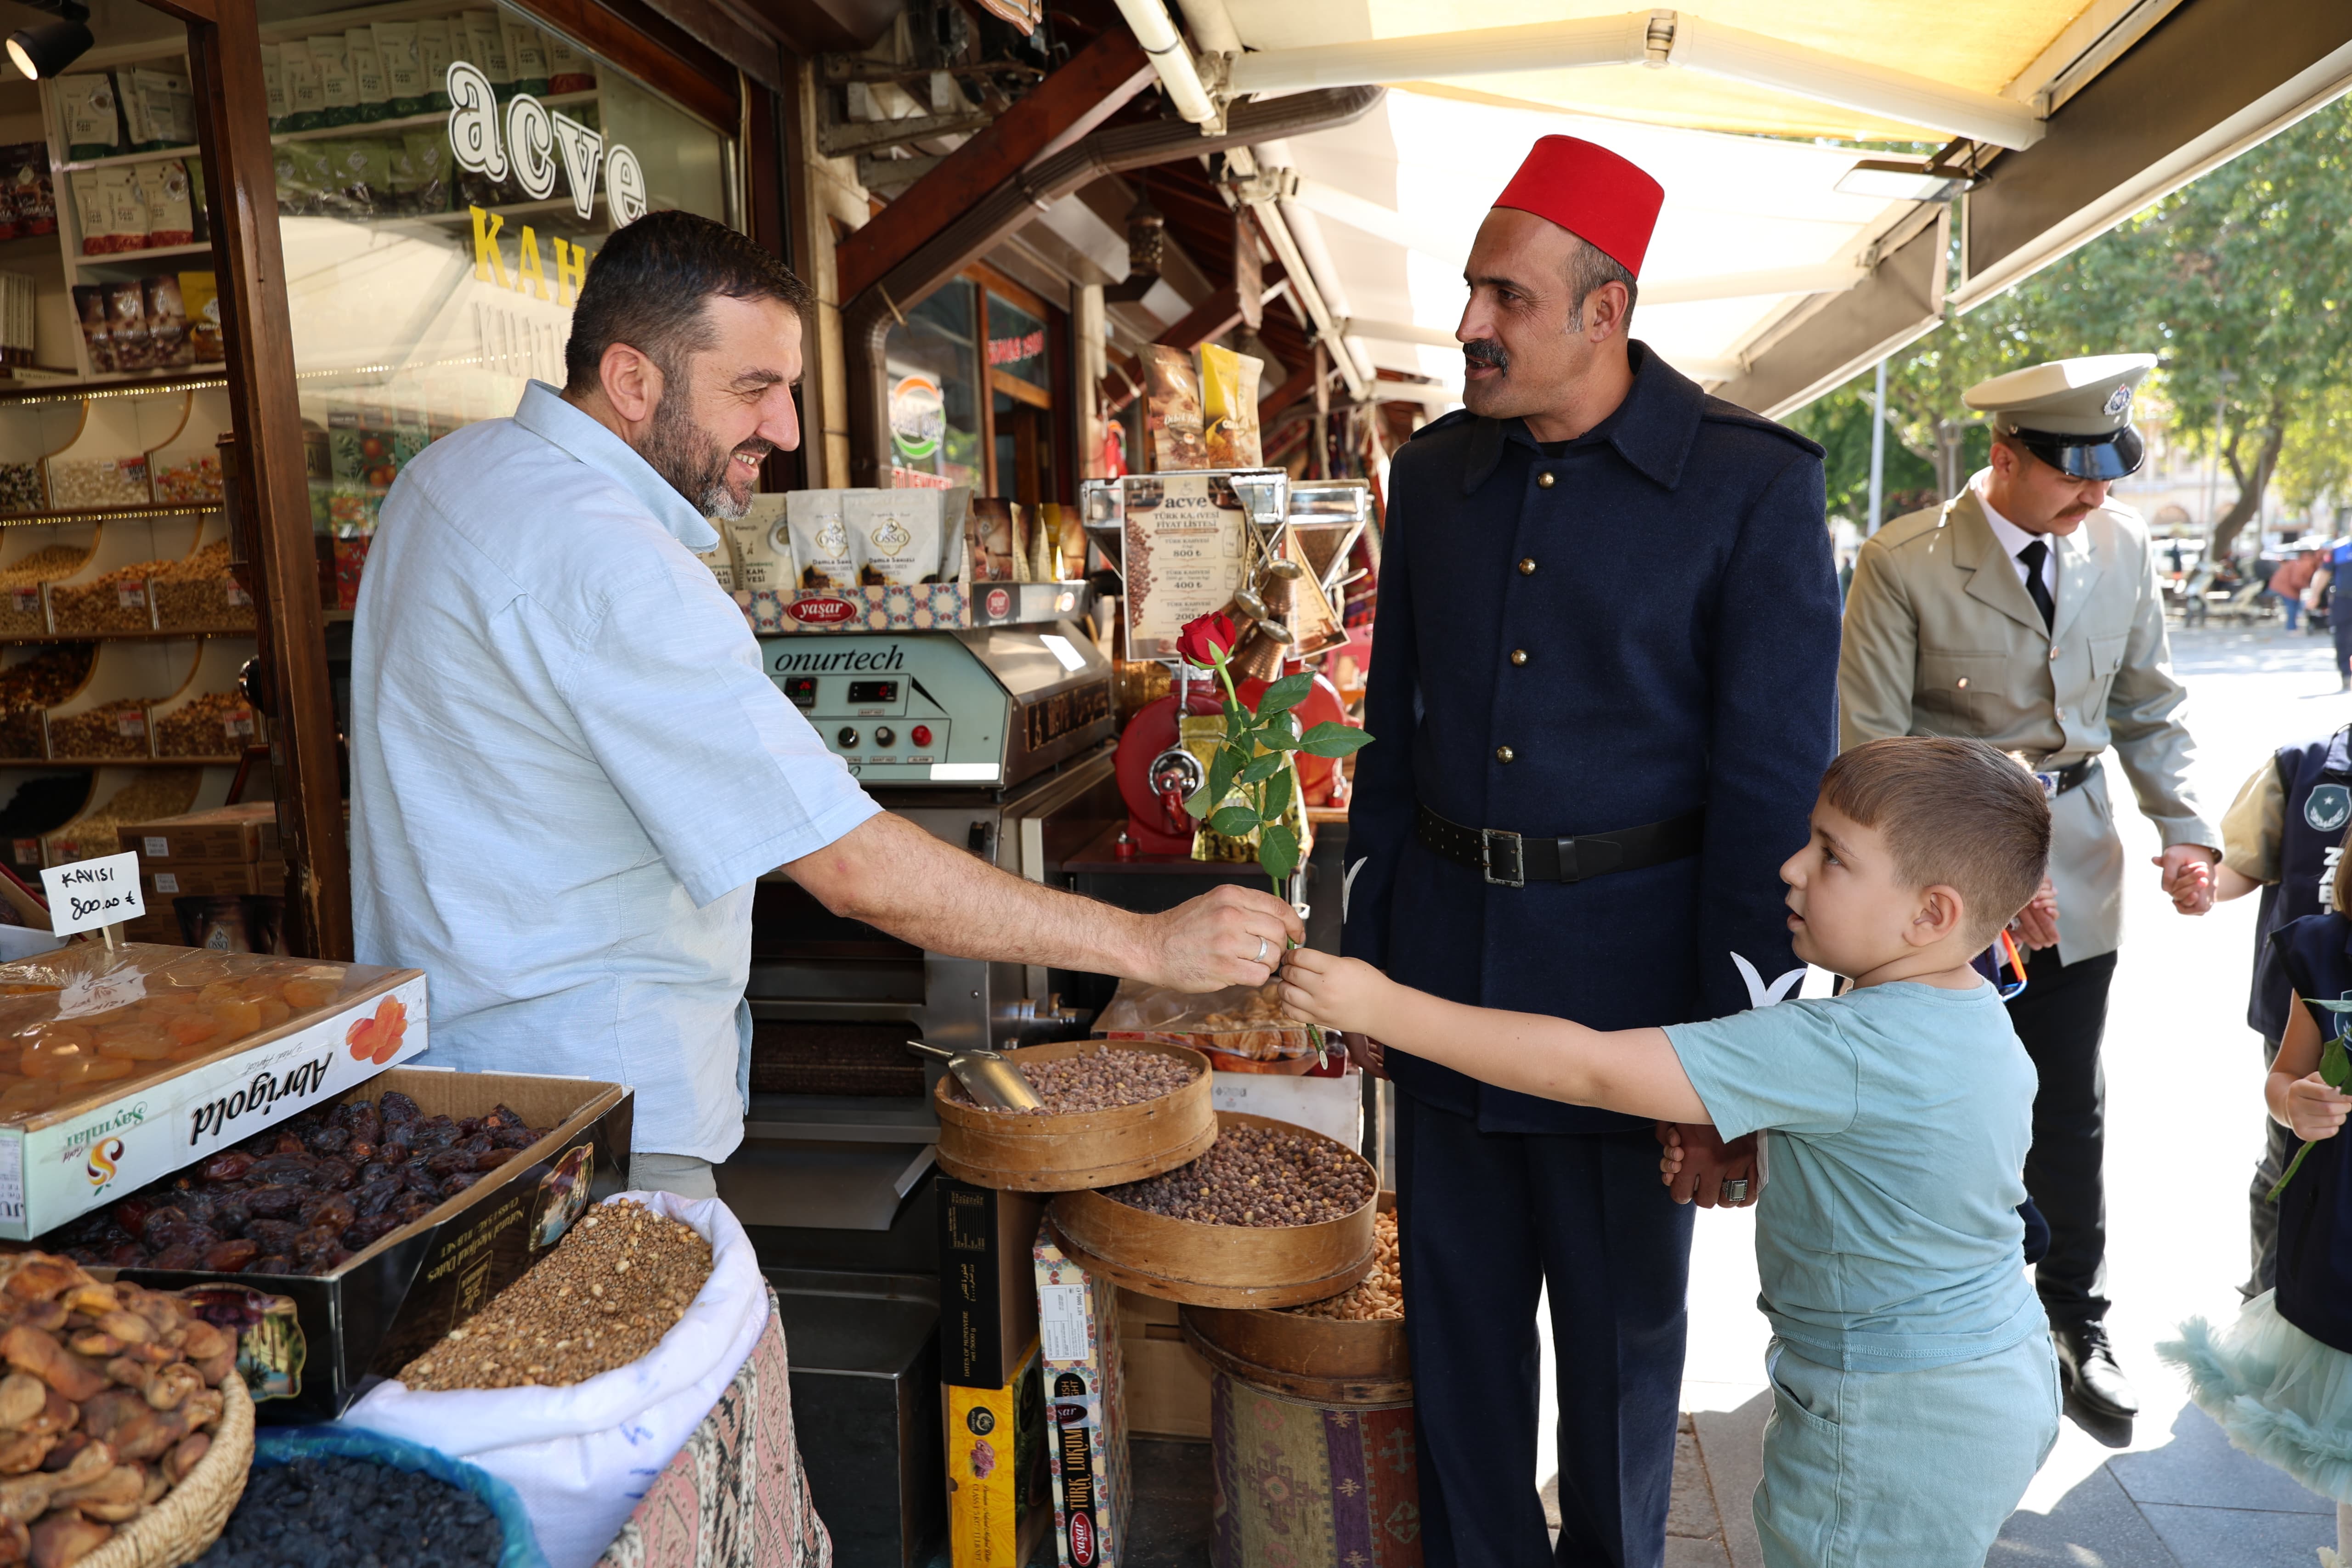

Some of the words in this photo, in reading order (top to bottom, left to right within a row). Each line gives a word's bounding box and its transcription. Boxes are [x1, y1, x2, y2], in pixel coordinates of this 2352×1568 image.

[447, 61, 647, 230] acve
[469, 205, 597, 307] KAH
[1165, 496, 1207, 508] acve
[876, 533, 906, 543] OSSO
[799, 603, 843, 619] yaşar
[775, 644, 904, 671] onurtech
[189, 1050, 335, 1147] Abrigold
[493, 1206, 525, 1239] Natural
[963, 1347, 970, 1357] OF
[1058, 1407, 1077, 1418] şar
[1065, 1473, 1091, 1510] TÜRK
[1074, 1521, 1090, 1557] yaşar
